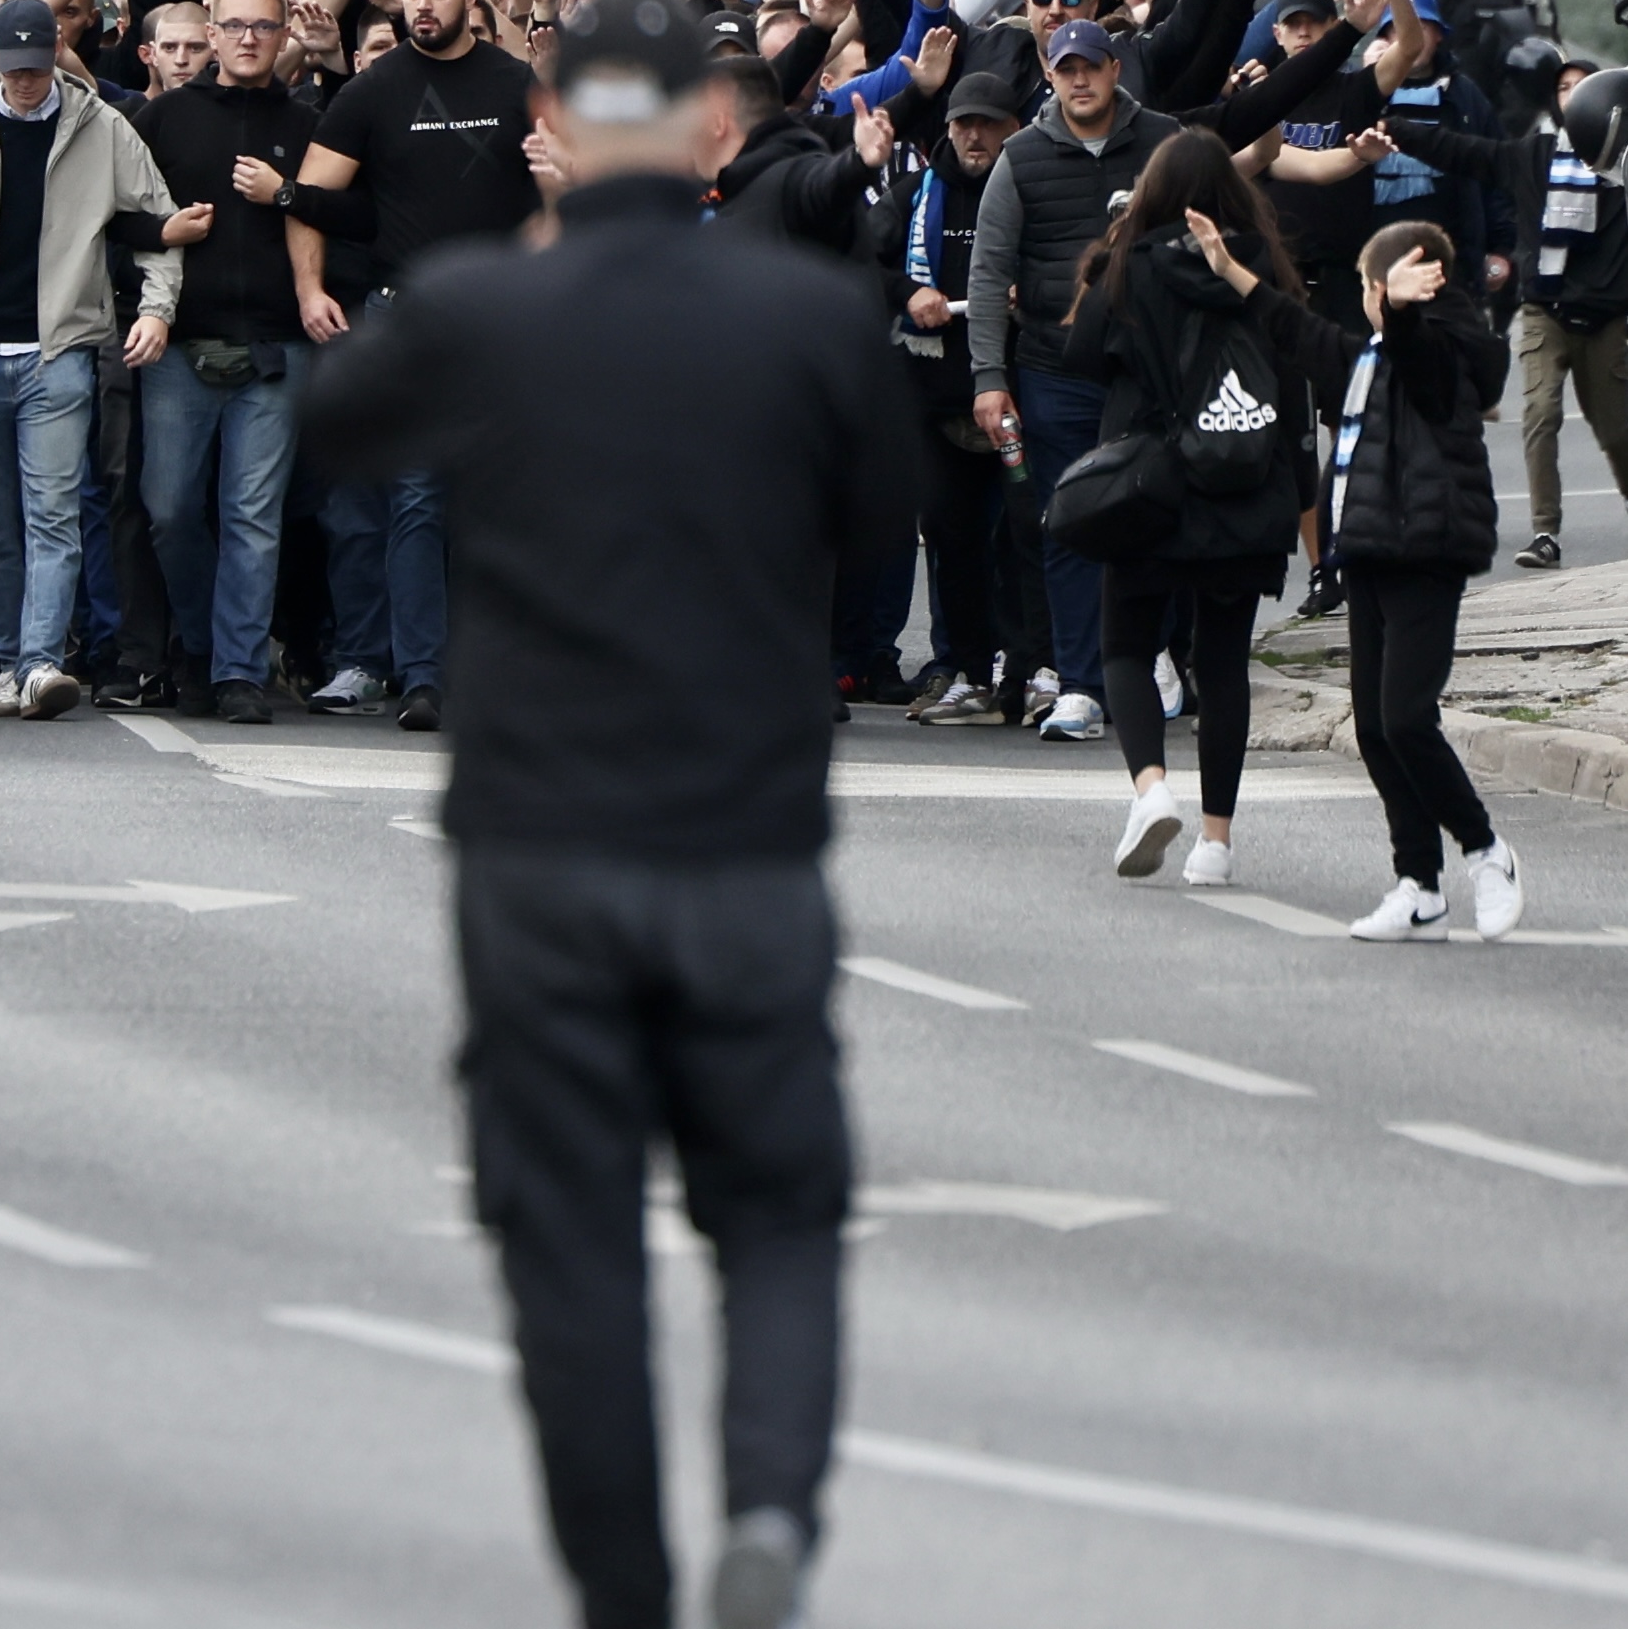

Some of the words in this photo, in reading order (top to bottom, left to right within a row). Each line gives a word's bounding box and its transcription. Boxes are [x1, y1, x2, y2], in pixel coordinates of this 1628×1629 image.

[410, 122, 446, 131] ARMANI
[449, 117, 500, 130] EXCHANGE
[1198, 402, 1278, 432] adidas
